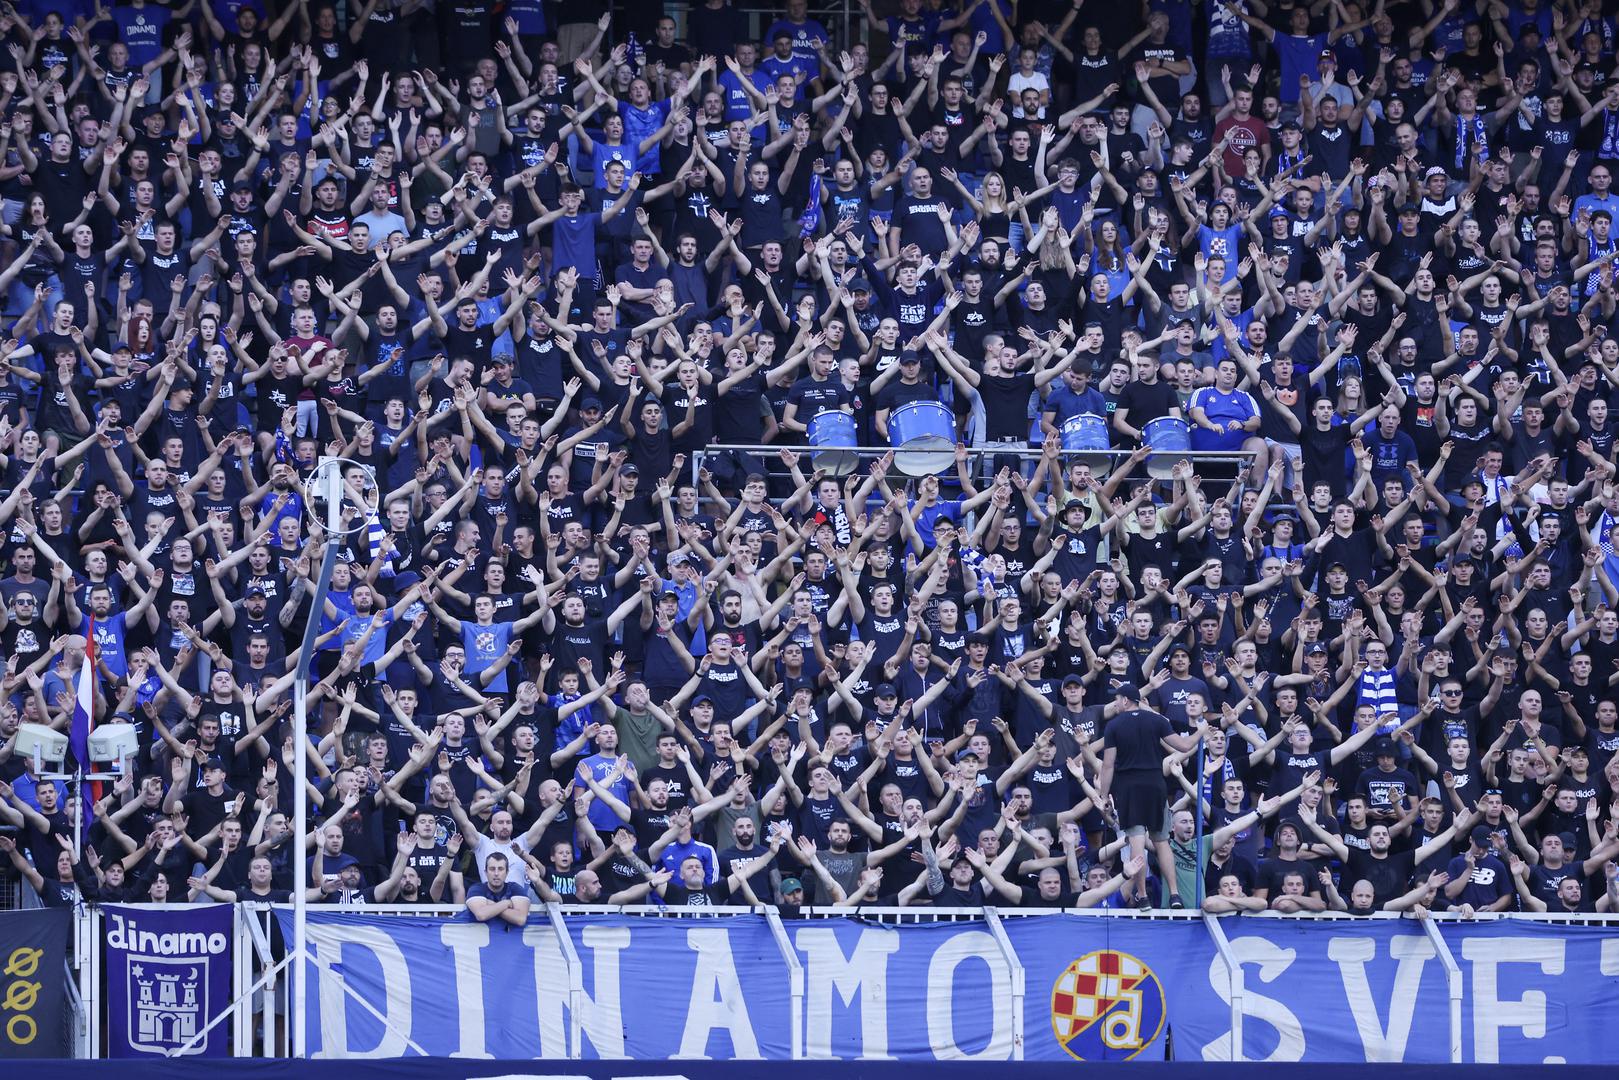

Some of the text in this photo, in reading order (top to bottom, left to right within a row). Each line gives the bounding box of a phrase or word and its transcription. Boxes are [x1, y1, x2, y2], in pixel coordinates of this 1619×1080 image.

[127, 24, 157, 36] DINAMO
[1575, 788, 1596, 798] didas
[107, 914, 227, 955] dinamo
[306, 921, 1619, 1063] DINAMO SVE
